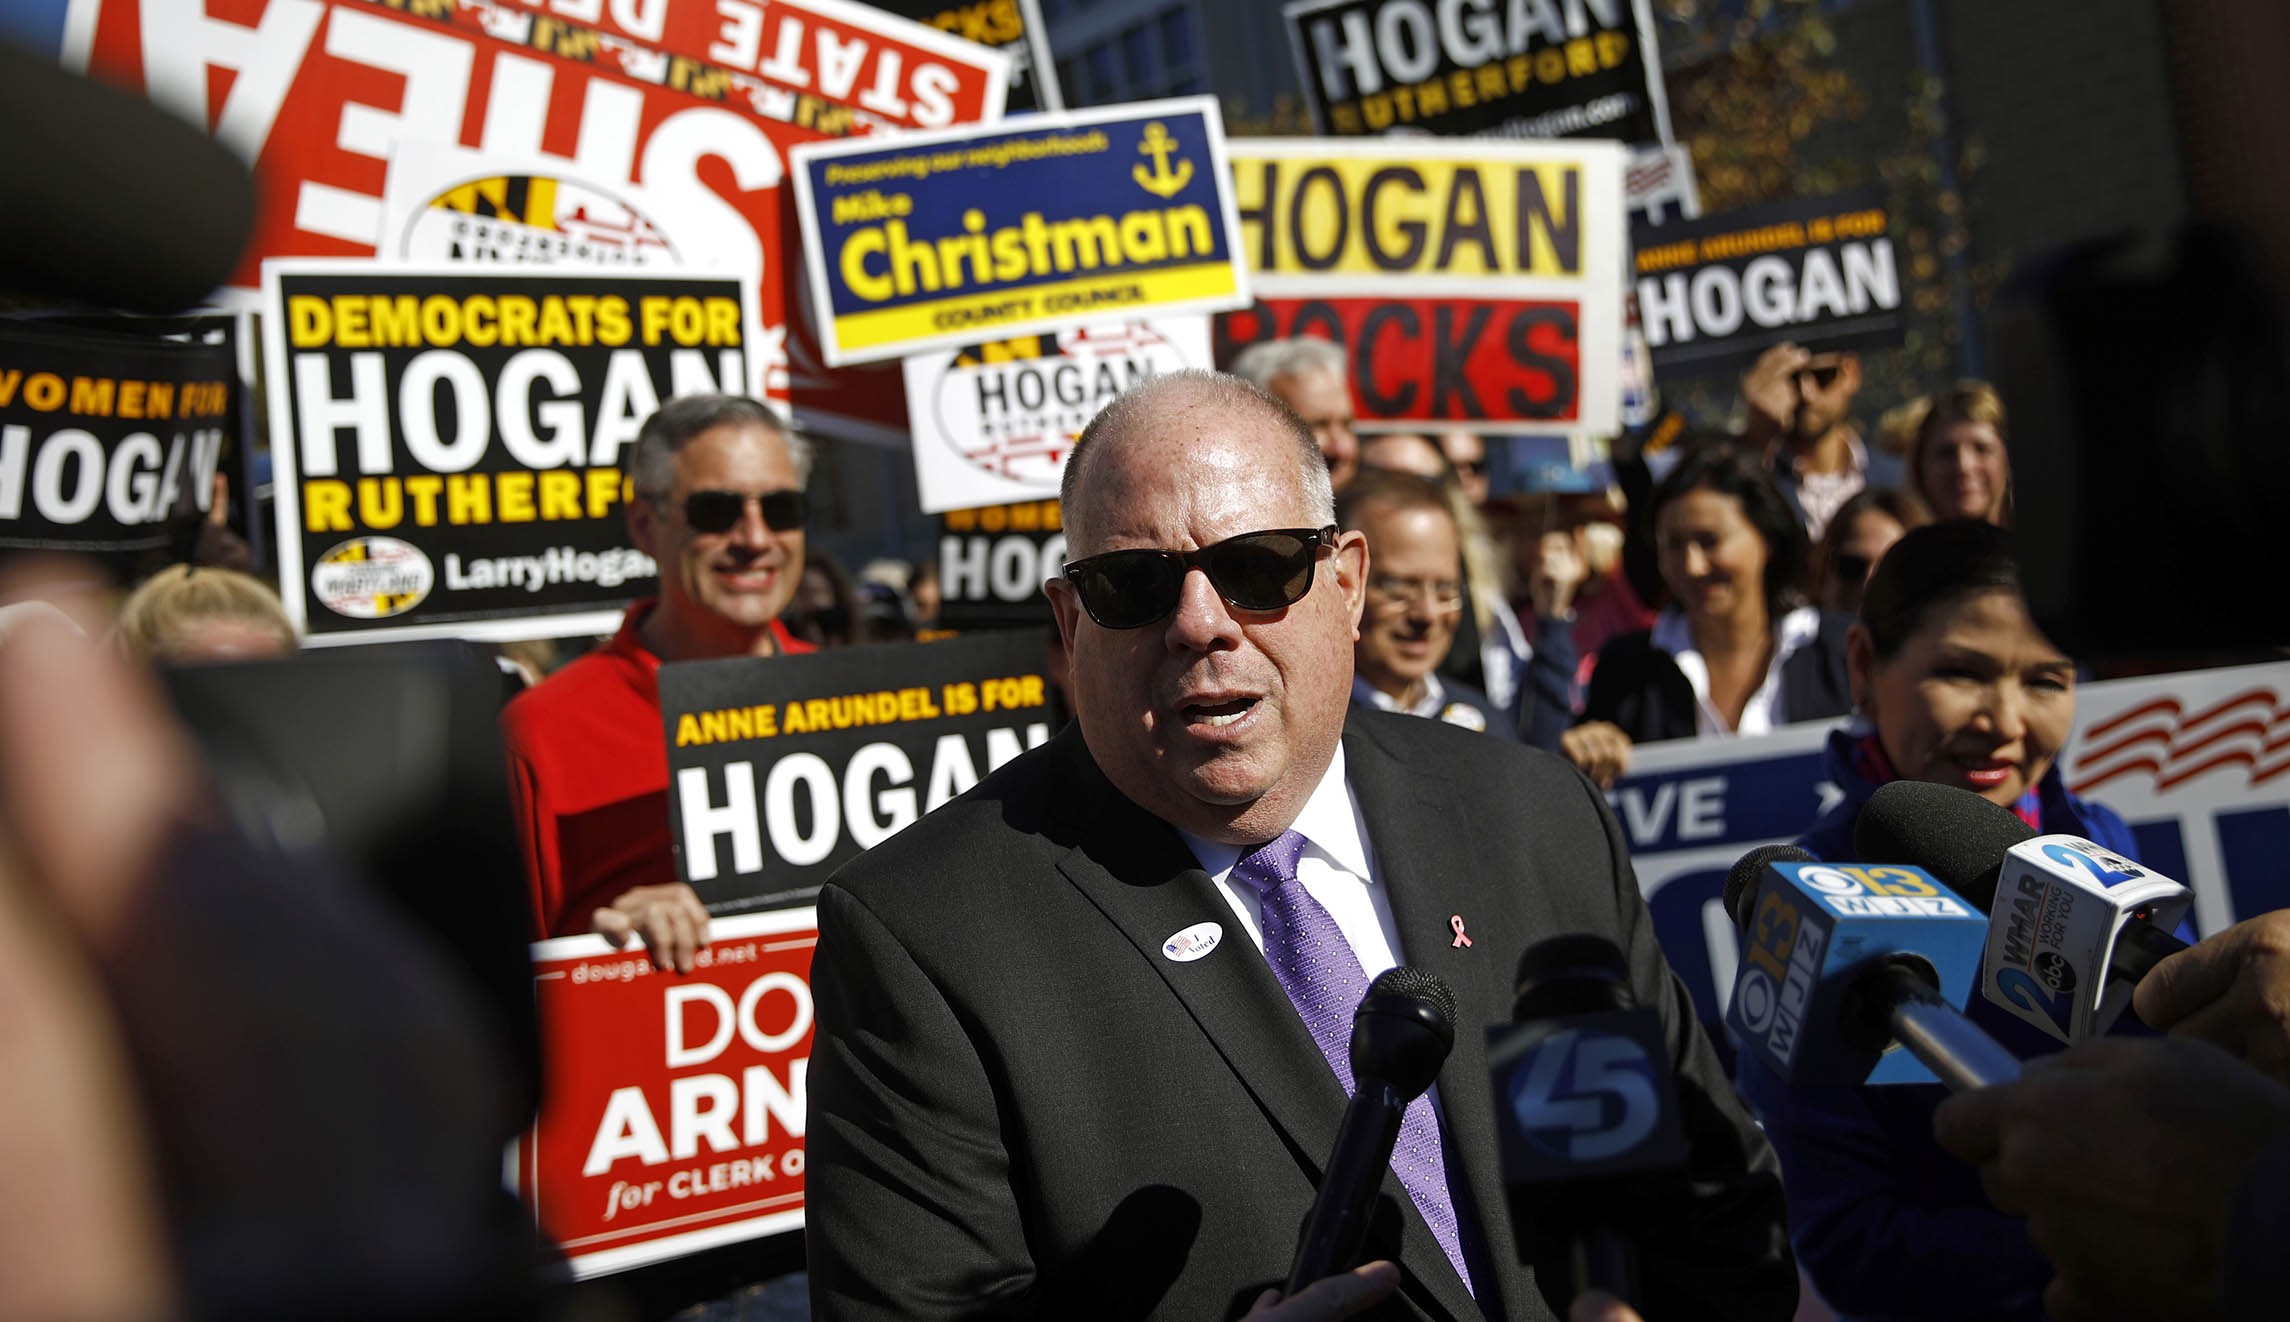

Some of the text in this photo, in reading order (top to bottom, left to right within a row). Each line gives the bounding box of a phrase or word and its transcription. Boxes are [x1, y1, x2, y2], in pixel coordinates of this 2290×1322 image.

[709, 0, 960, 128] STATE
[826, 131, 1109, 186] Preserving our neighborhoods
[832, 188, 913, 224] Mike
[1234, 161, 1581, 275] HOGAN
[1701, 221, 1805, 261] ARUNDEL
[1835, 208, 1888, 239] FOR
[839, 204, 1214, 302] Christman
[288, 294, 741, 347] DEMOCRATS FOR
[932, 298, 1034, 331] COUNTY
[1636, 237, 1901, 347] HOGAN
[304, 467, 634, 532] RUTHERF
[676, 674, 1044, 748] ANNE ARUNDEL IS FOR
[1604, 774, 1728, 847] VE
[1837, 866, 1940, 897] 13
[2041, 844, 2138, 888] 2
[1193, 933, 1200, 942] I
[1748, 891, 1799, 984] 13
[1826, 896, 1967, 917] WJZ
[2003, 873, 2047, 966] WMAR
[2039, 886, 2063, 945] WORKING
[2050, 890, 2075, 951] FOR YOU
[1188, 935, 1216, 954] Voted
[2043, 955, 2065, 989] abc
[1769, 917, 1823, 1063] WJZ
[1996, 967, 2074, 1039] 2
[582, 1057, 808, 1178] ARN
[1513, 1029, 1659, 1160] 45
[602, 1179, 662, 1222] for
[667, 1152, 775, 1199] CLERK
